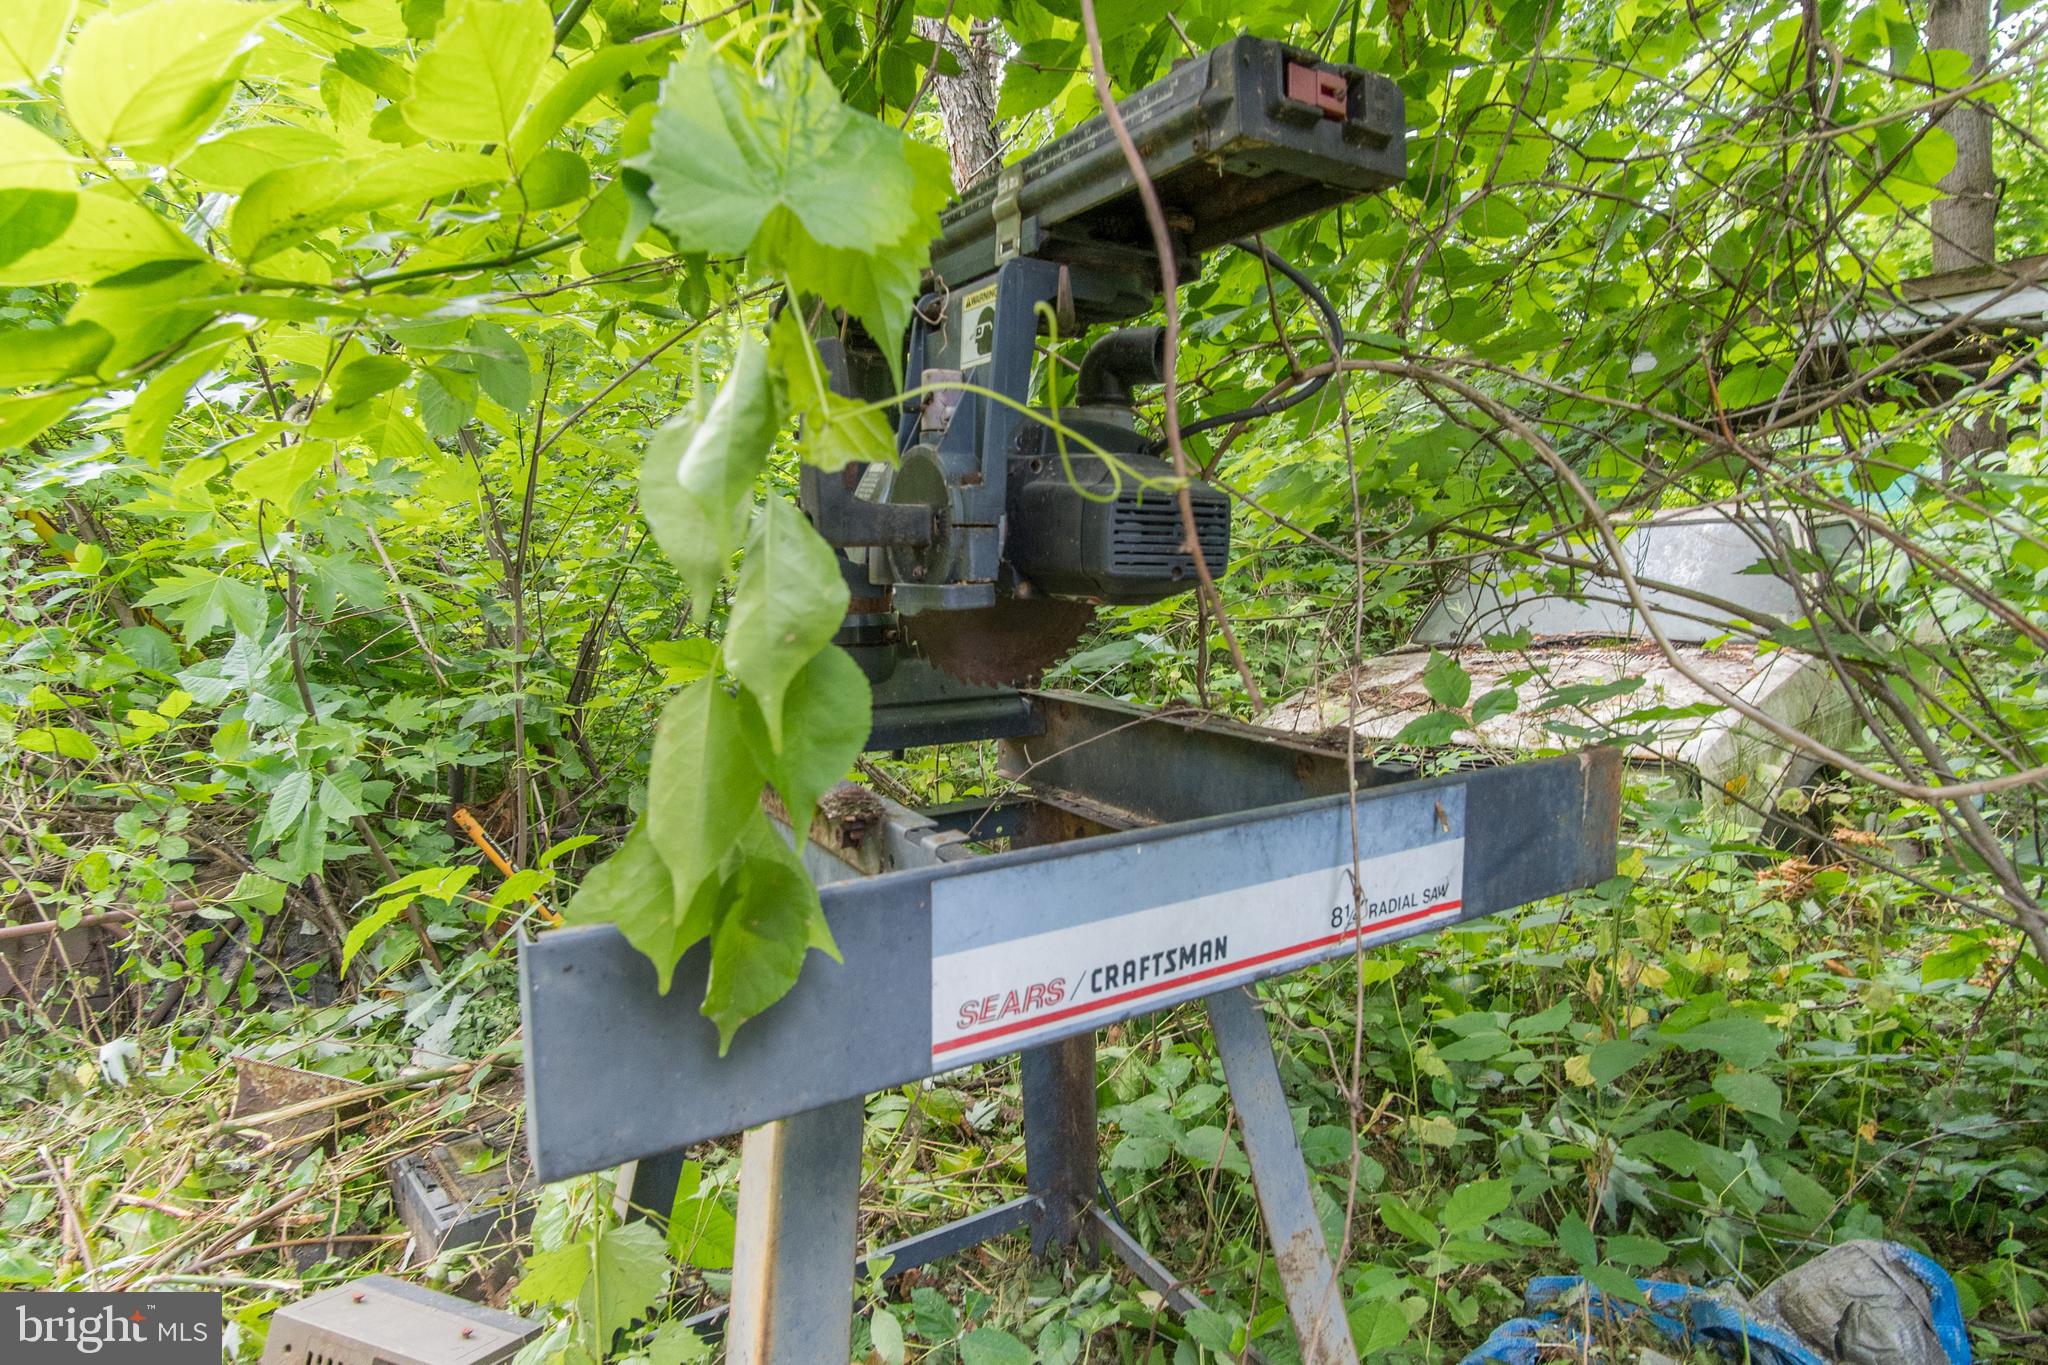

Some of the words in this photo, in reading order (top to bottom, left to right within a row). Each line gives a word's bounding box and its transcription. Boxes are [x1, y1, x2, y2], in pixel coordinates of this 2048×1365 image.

[1369, 893, 1418, 919] RADIAL
[1423, 882, 1450, 904] SAW
[957, 977, 1066, 1029] SEARS
[1090, 935, 1228, 993] CRAFTSMAN
